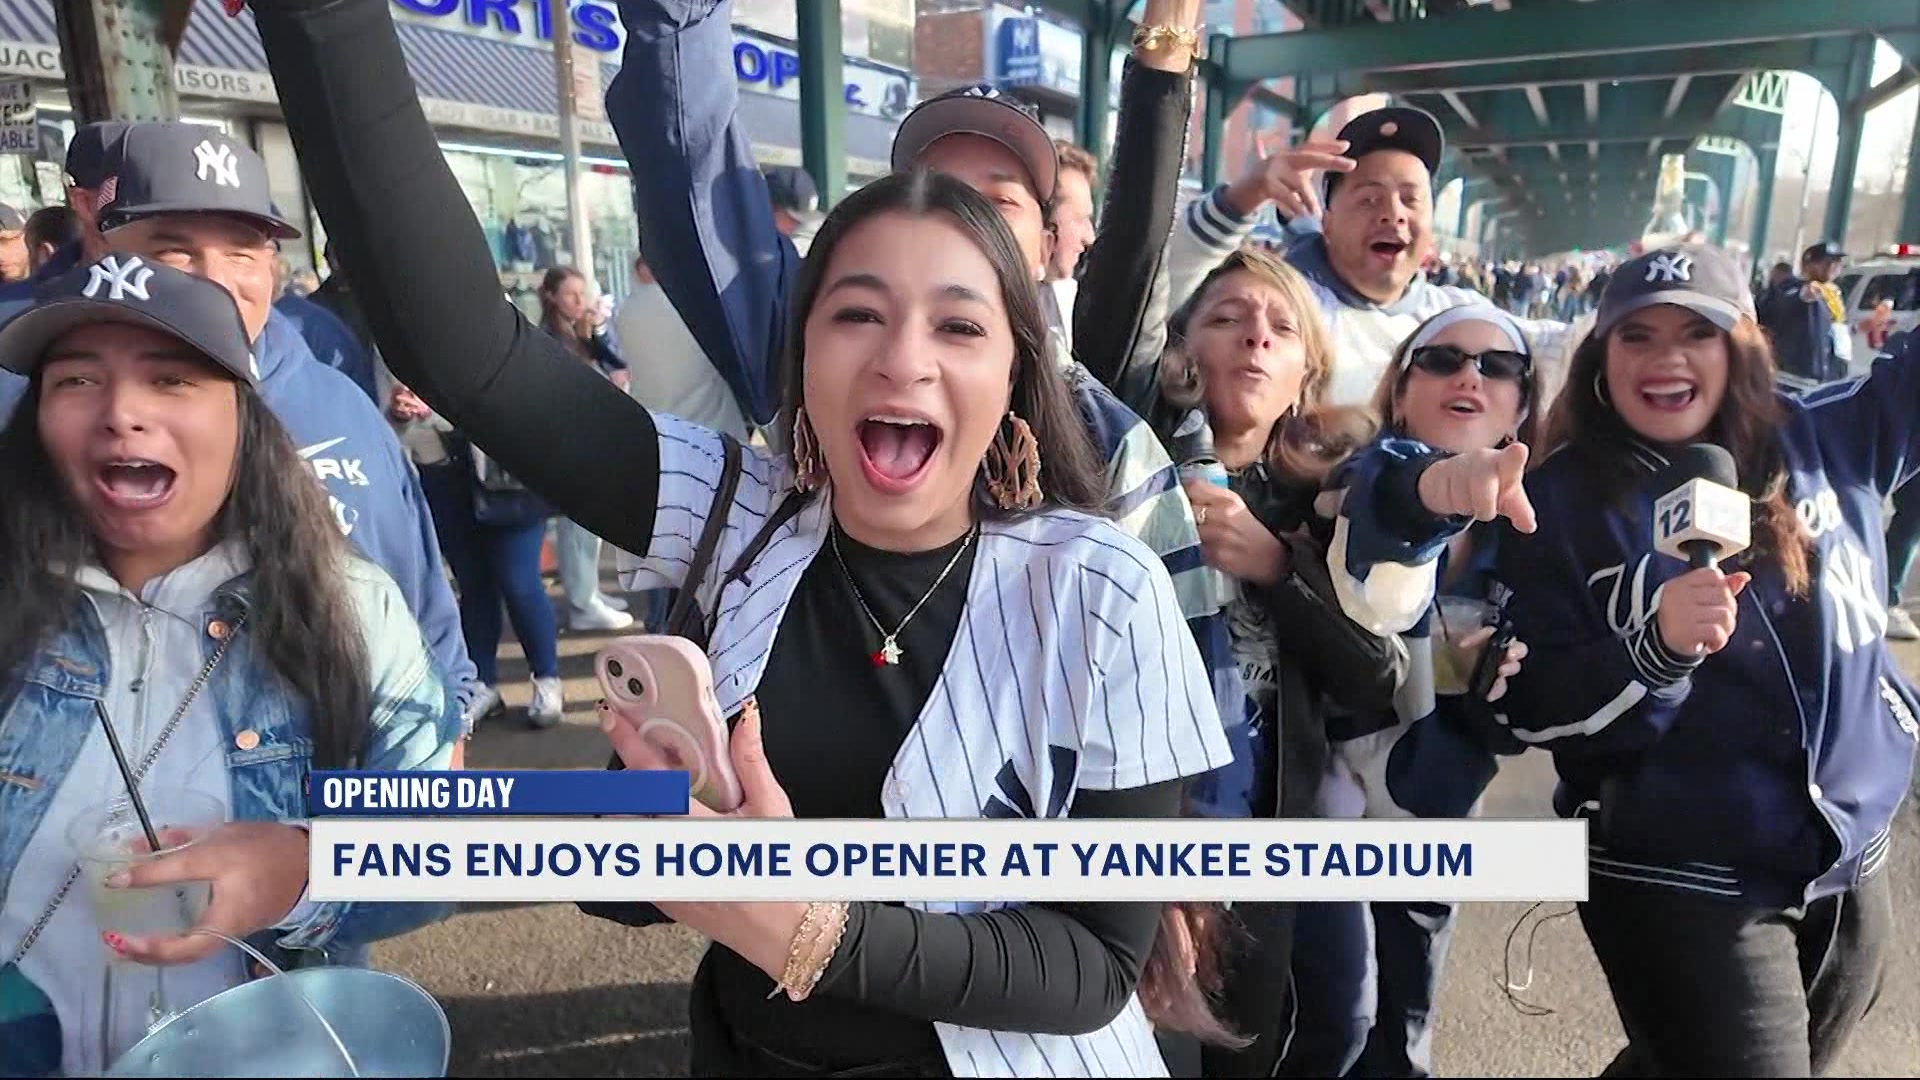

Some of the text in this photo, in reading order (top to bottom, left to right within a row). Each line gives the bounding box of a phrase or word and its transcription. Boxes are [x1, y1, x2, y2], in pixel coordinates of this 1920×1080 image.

[0, 47, 61, 70] JAC
[192, 140, 240, 188] NY
[81, 254, 155, 300] NY
[1645, 254, 1693, 282] NY
[308, 458, 369, 481] RK
[1659, 499, 1690, 538] 12
